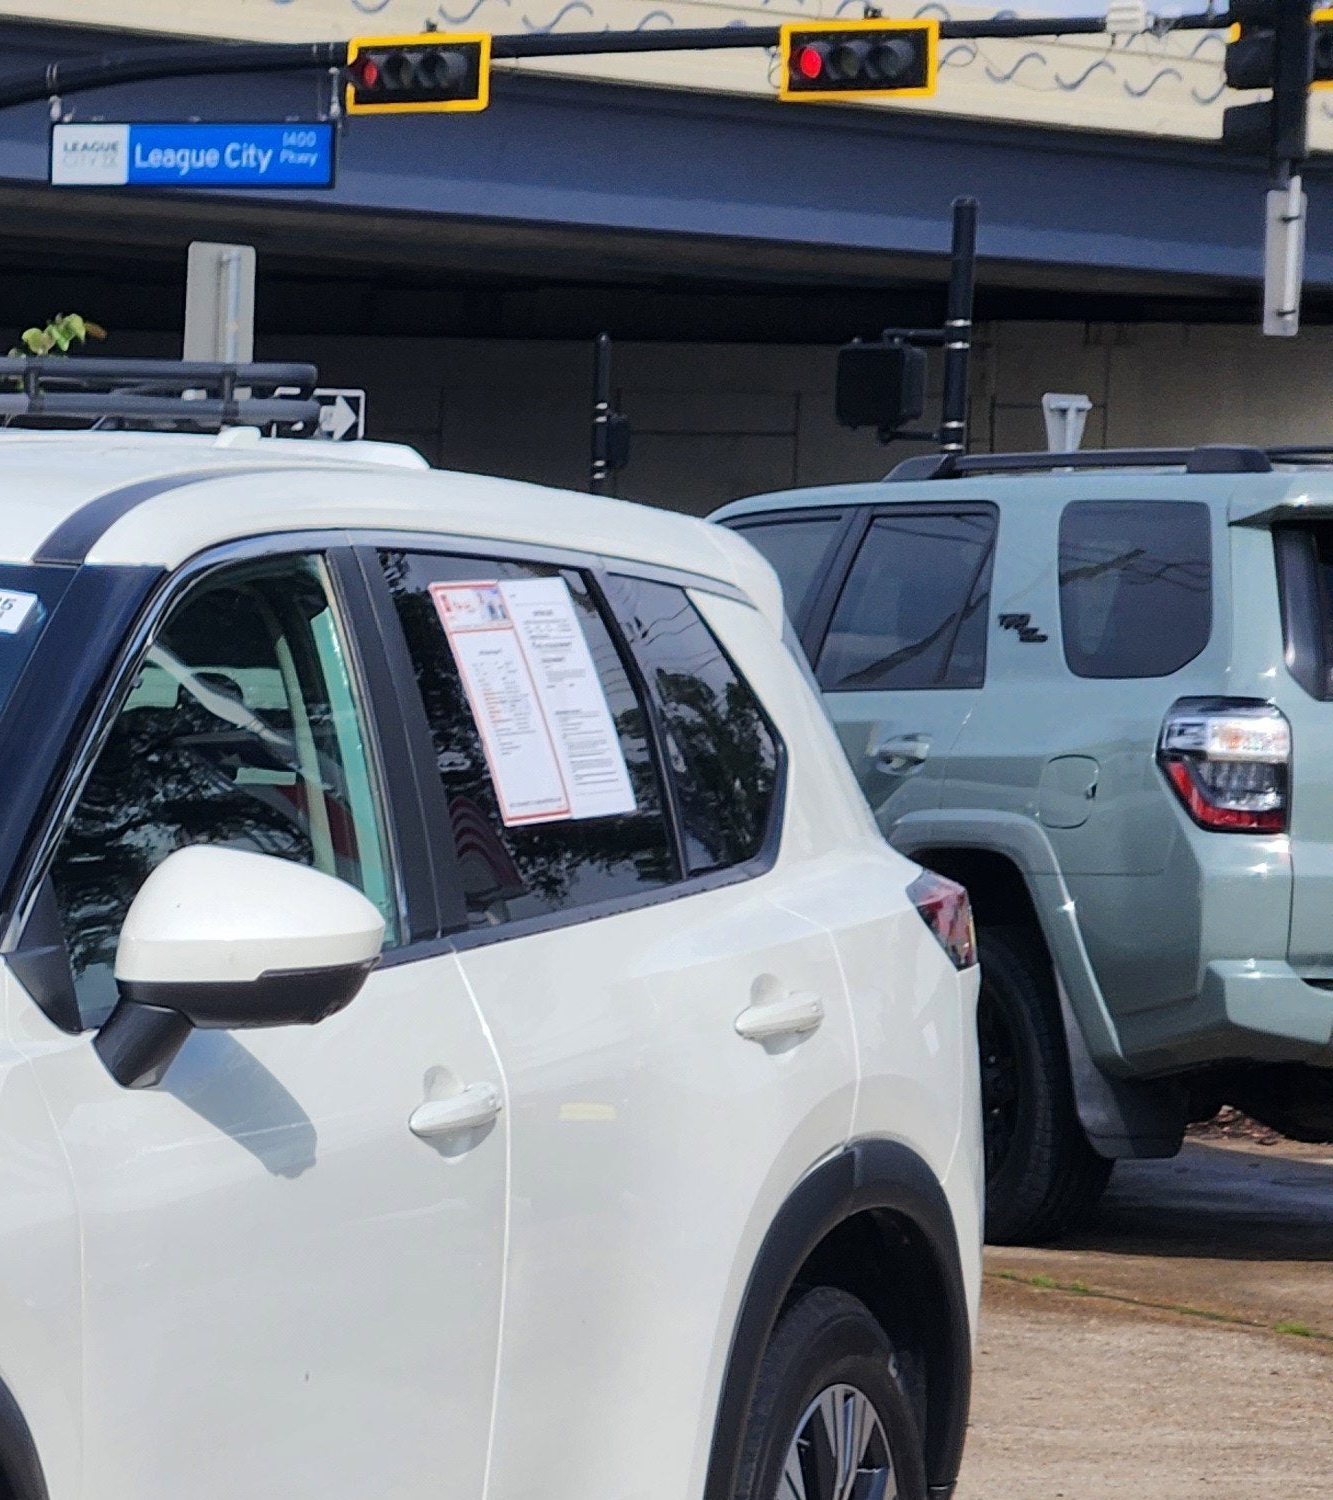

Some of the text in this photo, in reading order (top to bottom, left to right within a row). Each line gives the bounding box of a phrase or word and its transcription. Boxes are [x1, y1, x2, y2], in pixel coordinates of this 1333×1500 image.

[63, 140, 119, 152] LEAGUE
[282, 131, 317, 147] 1400
[134, 142, 274, 176] League City
